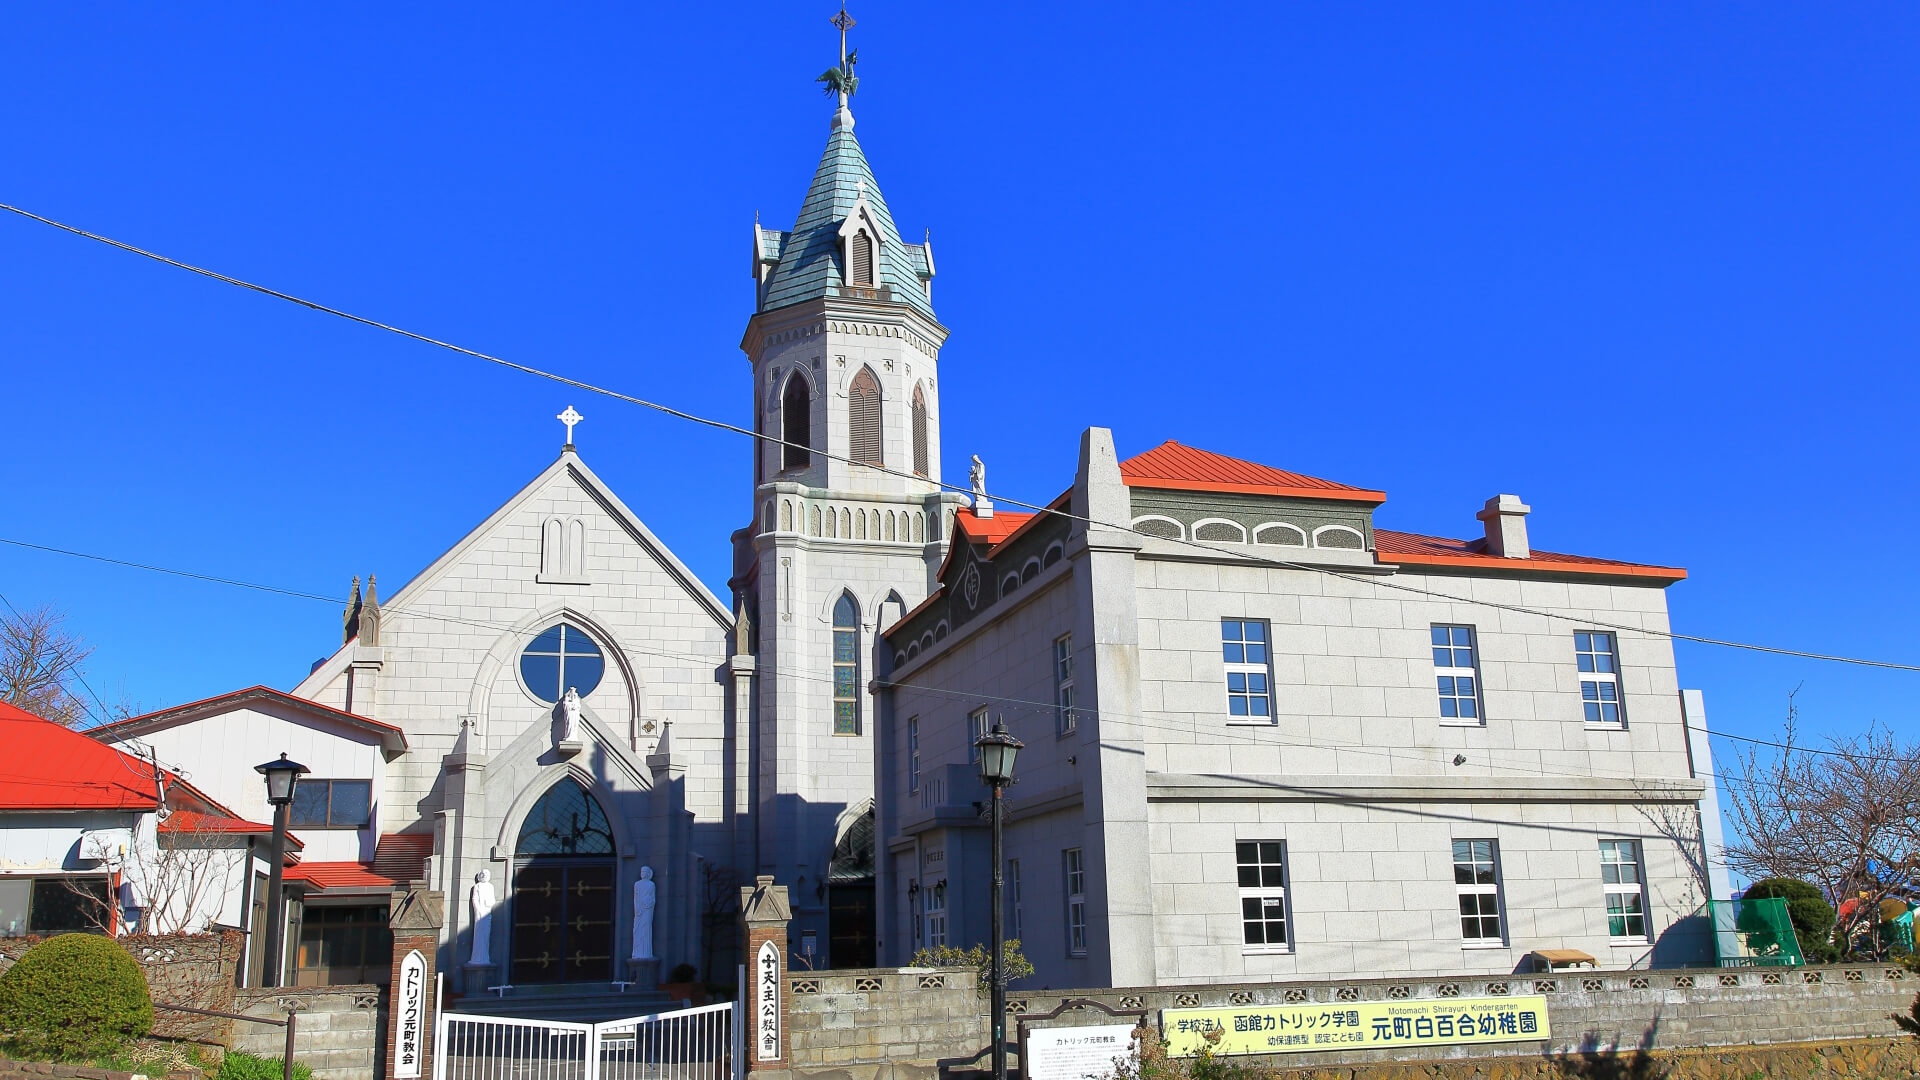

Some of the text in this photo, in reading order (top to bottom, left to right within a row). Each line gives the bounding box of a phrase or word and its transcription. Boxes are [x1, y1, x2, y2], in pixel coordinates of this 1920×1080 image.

[402, 966, 420, 1065] カトリック元町教会
[1388, 1002, 1518, 1015] Motomachi Shirayuri Kindergarten
[1178, 1010, 1359, 1033] 学校法人 函館カトリック学園
[1371, 1011, 1537, 1040] 元町白百合幼稚園
[1056, 1035, 1116, 1046] カトリック元町教会
[1267, 1031, 1364, 1046] 幼保連携型 認定こども園
